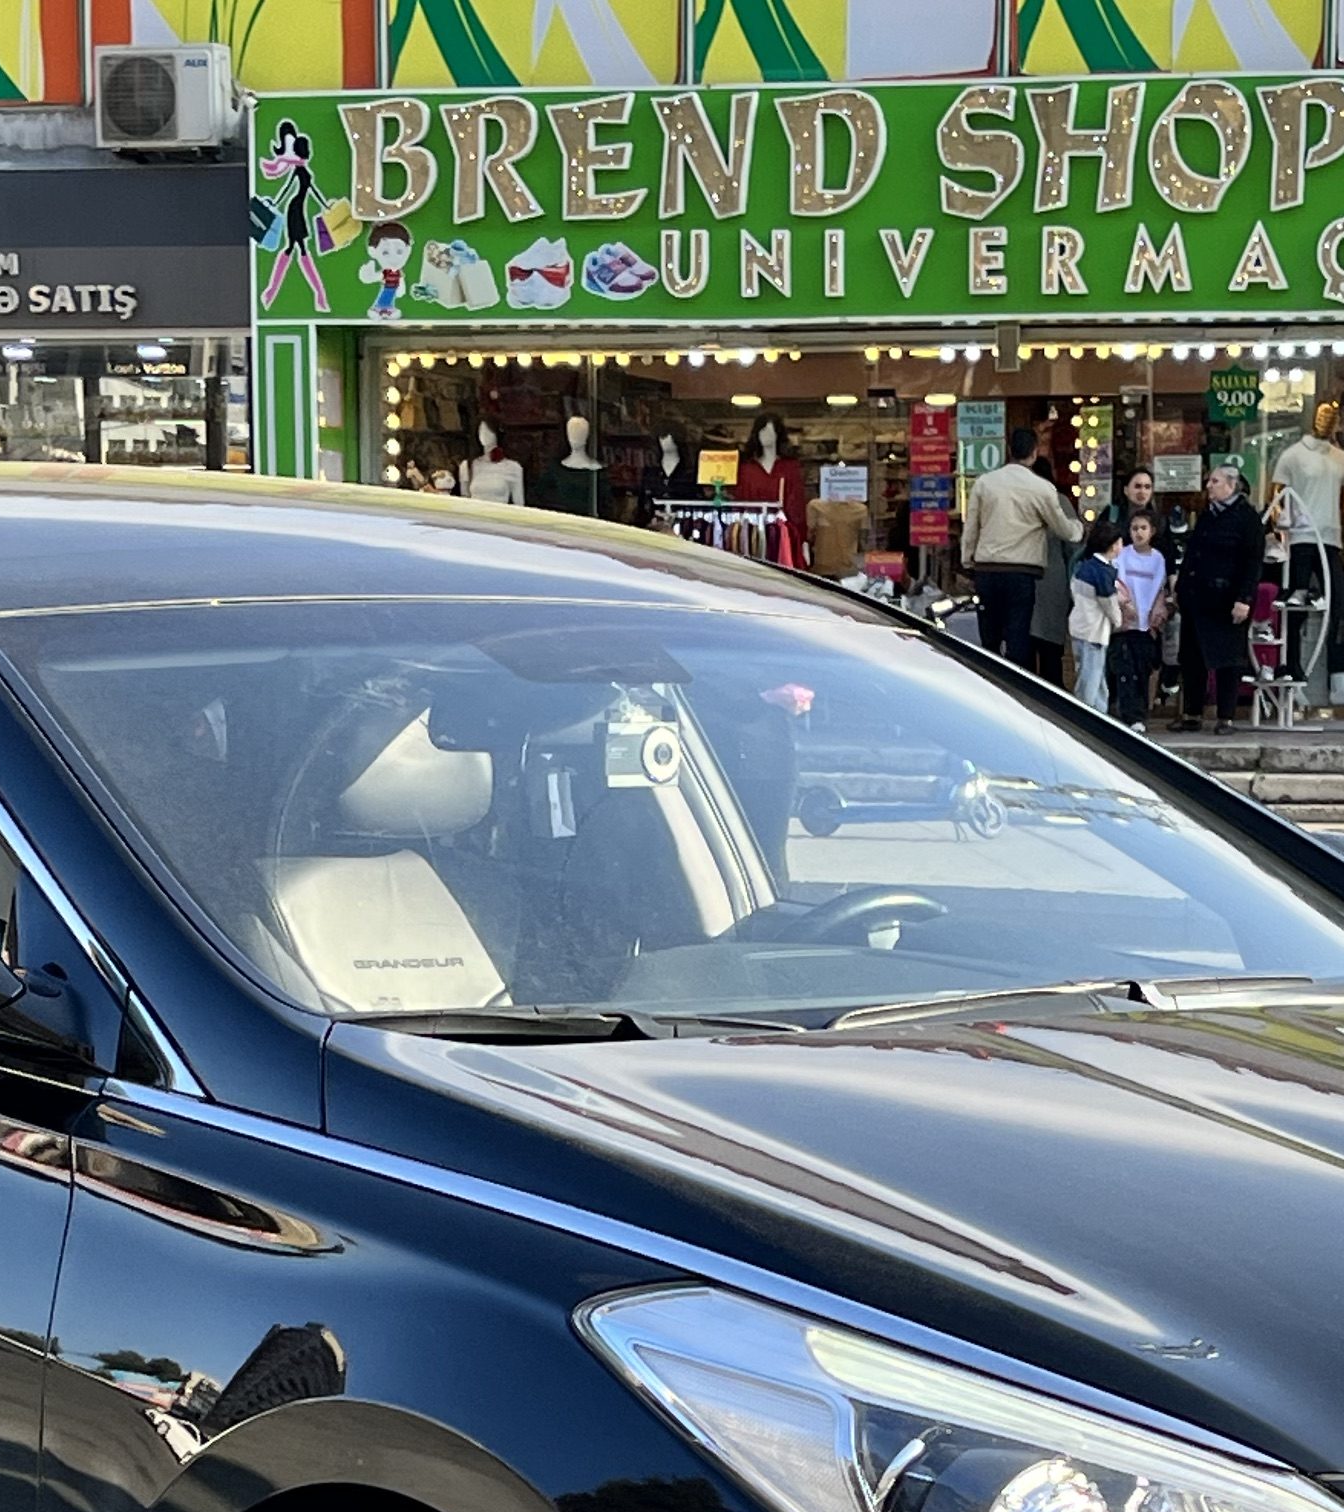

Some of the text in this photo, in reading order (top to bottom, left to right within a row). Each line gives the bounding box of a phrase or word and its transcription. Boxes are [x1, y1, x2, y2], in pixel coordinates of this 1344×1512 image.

[337, 89, 888, 224] BREND
[28, 283, 138, 321] SATIŞ
[1216, 389, 1255, 407] 9.00
[963, 444, 1001, 470] 10
[353, 957, 464, 969] GRANDEUR
